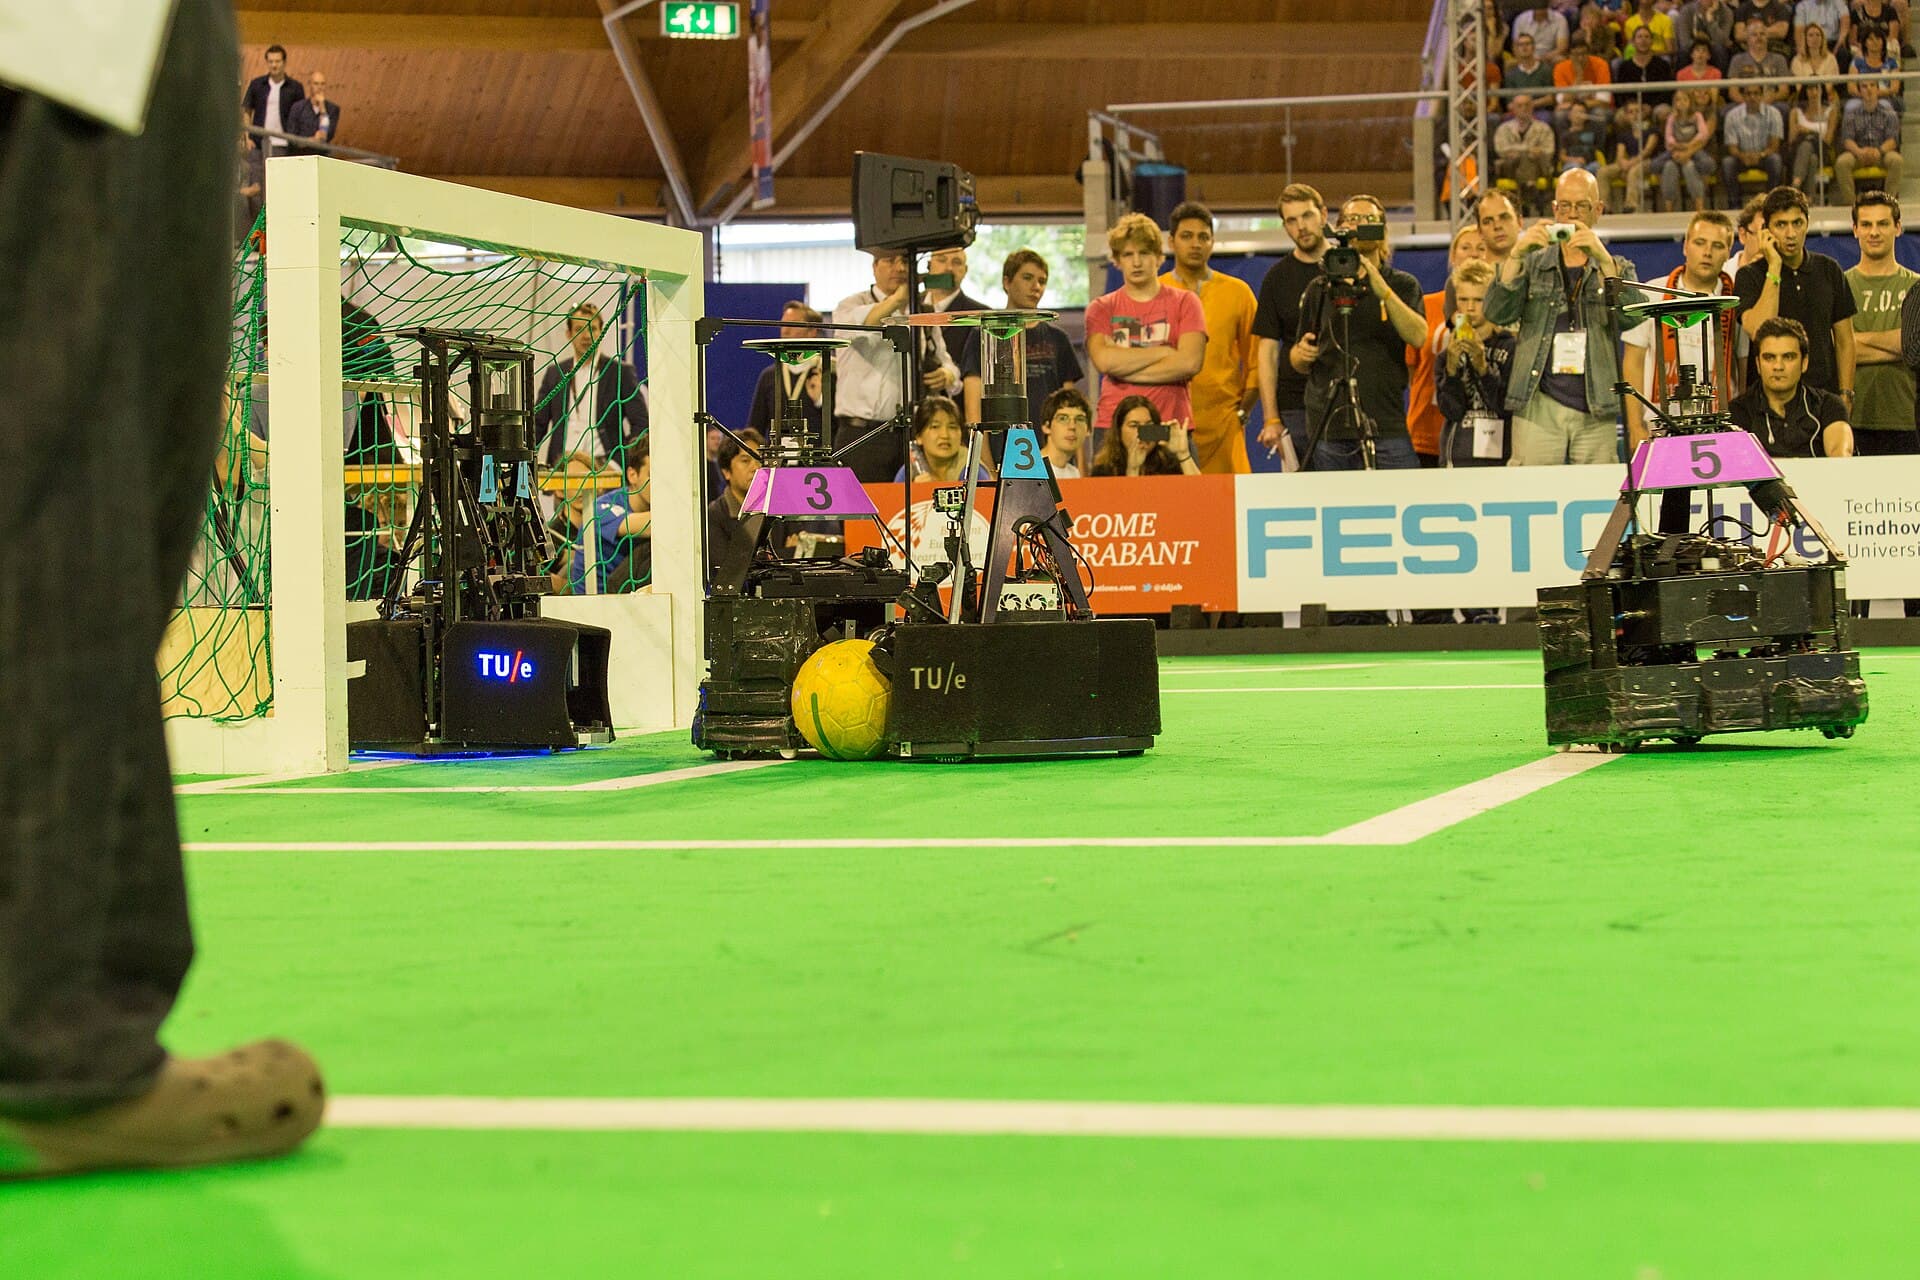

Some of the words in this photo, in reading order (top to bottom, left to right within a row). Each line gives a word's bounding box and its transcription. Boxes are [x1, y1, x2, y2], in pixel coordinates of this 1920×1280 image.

[1014, 438, 1035, 470] 3
[1690, 439, 1721, 479] 5
[804, 472, 833, 511] 3
[1070, 512, 1157, 538] COME
[1848, 520, 1920, 536] Eindhov
[478, 650, 532, 683] TU/e
[910, 661, 966, 695] TU/e
